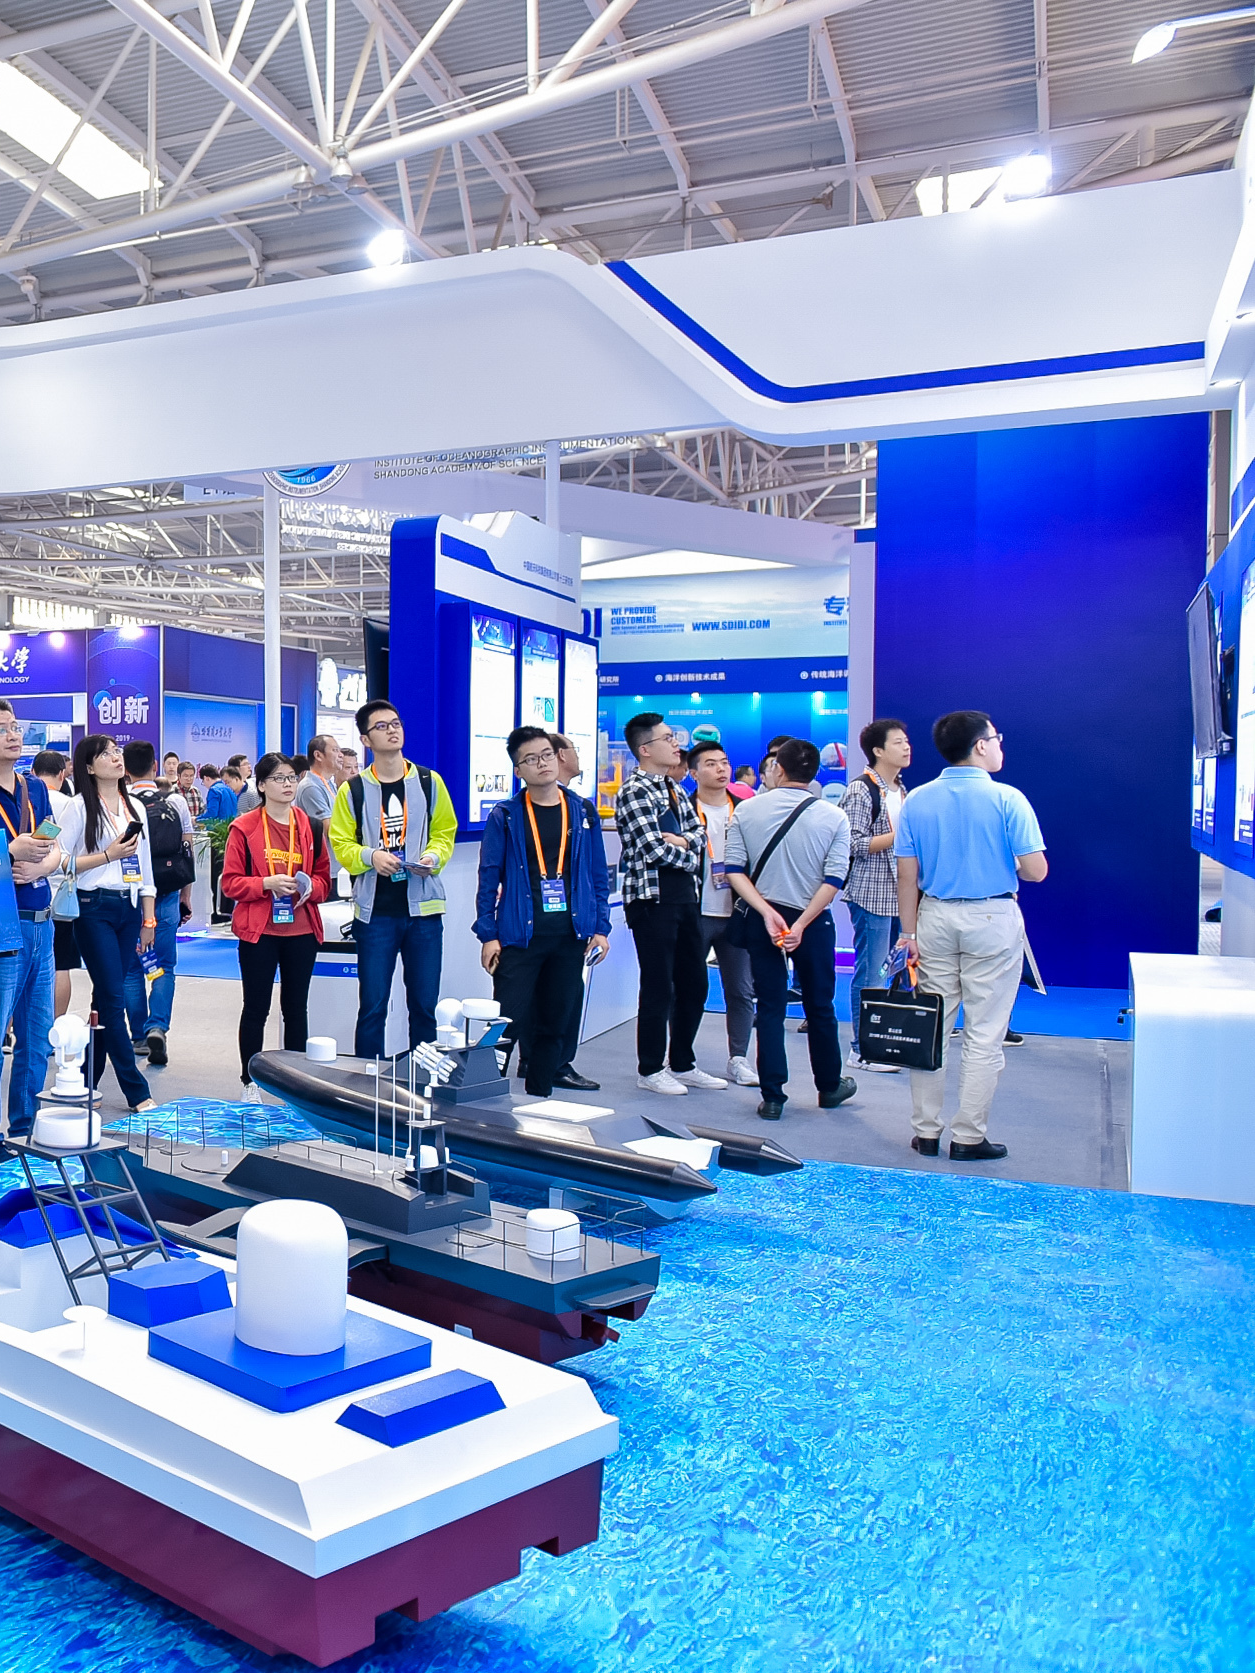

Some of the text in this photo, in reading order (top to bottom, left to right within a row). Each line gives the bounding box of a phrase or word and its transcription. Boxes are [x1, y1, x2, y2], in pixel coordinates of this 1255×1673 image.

[374, 456, 424, 468] INSTITUTE
[373, 467, 429, 479] SHANDONG
[297, 475, 316, 484] 1966
[611, 605, 657, 616] WE PROVIDE
[610, 615, 657, 625] CUSTOMERS
[691, 619, 771, 632] WWW.SDIDI.COM
[98, 696, 149, 725] 创新
